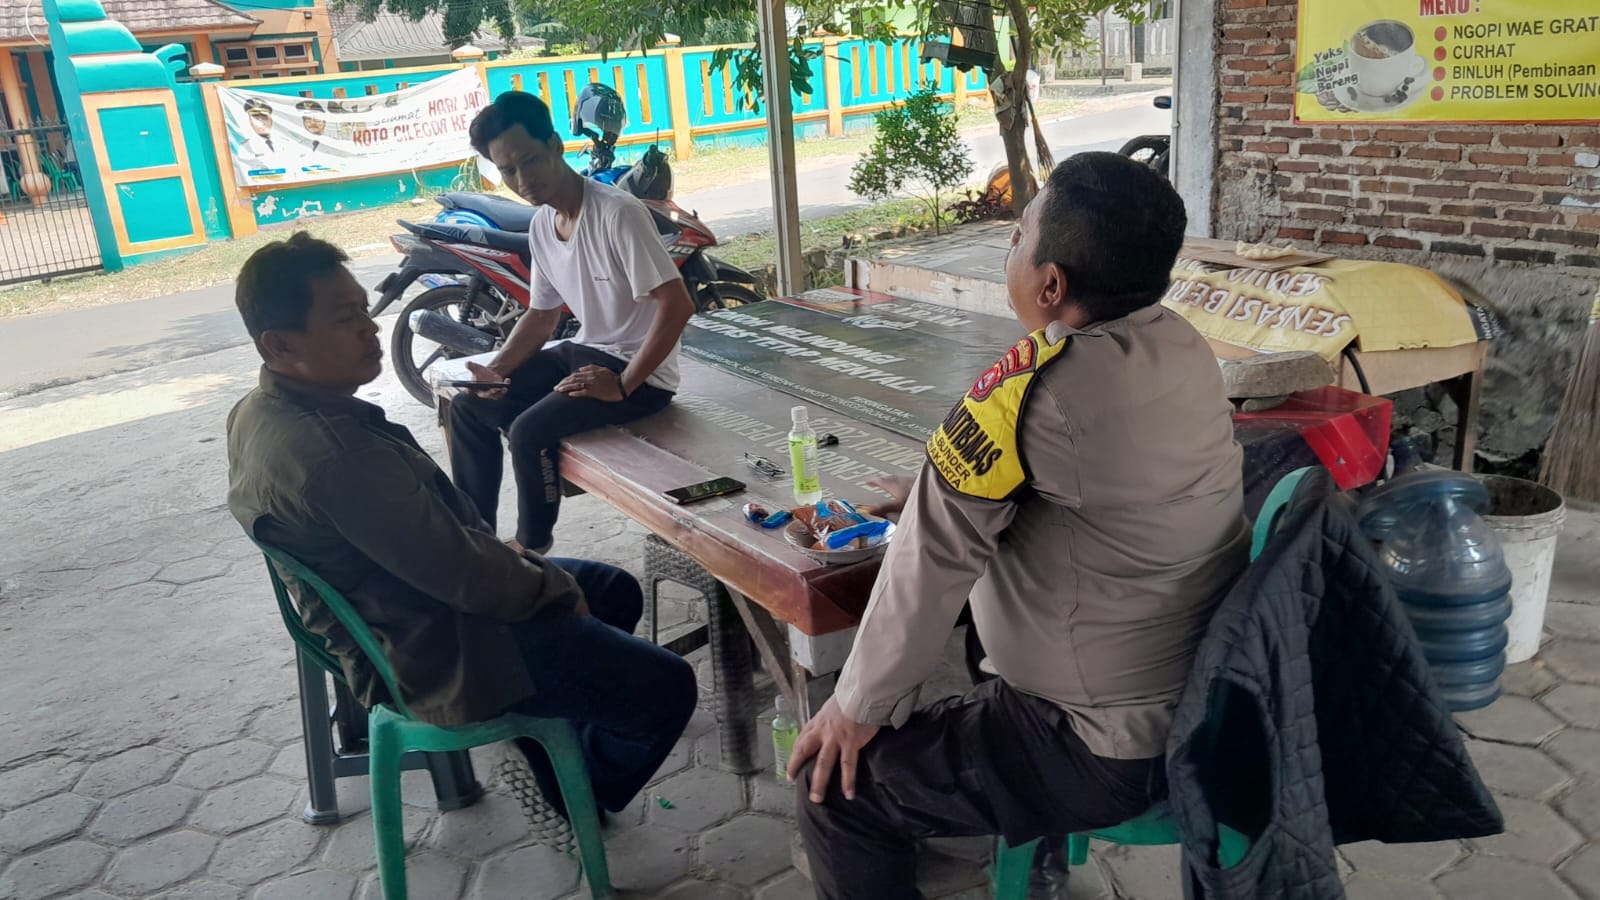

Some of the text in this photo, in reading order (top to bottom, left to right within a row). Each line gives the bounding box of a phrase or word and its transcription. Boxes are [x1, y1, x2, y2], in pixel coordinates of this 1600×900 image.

[1419, 0, 1469, 16] MENU
[1453, 16, 1600, 39] NGOPI WAE GRAT
[1313, 48, 1343, 63] Yuks
[1453, 43, 1516, 60] CURHAT
[1316, 60, 1349, 80] Ngopi
[1452, 63, 1596, 80] BINLUH (Pembinaan
[1317, 74, 1359, 92] Bareng
[1450, 83, 1600, 100] PROBLEM SOLVIN
[452, 113, 468, 132] KE
[1224, 294, 1352, 337] SENSASI
[761, 325, 907, 365] MELINDUNGI
[808, 357, 937, 394] MENYALA
[928, 442, 961, 489] AKARTA
[937, 436, 971, 480] BUNDER
